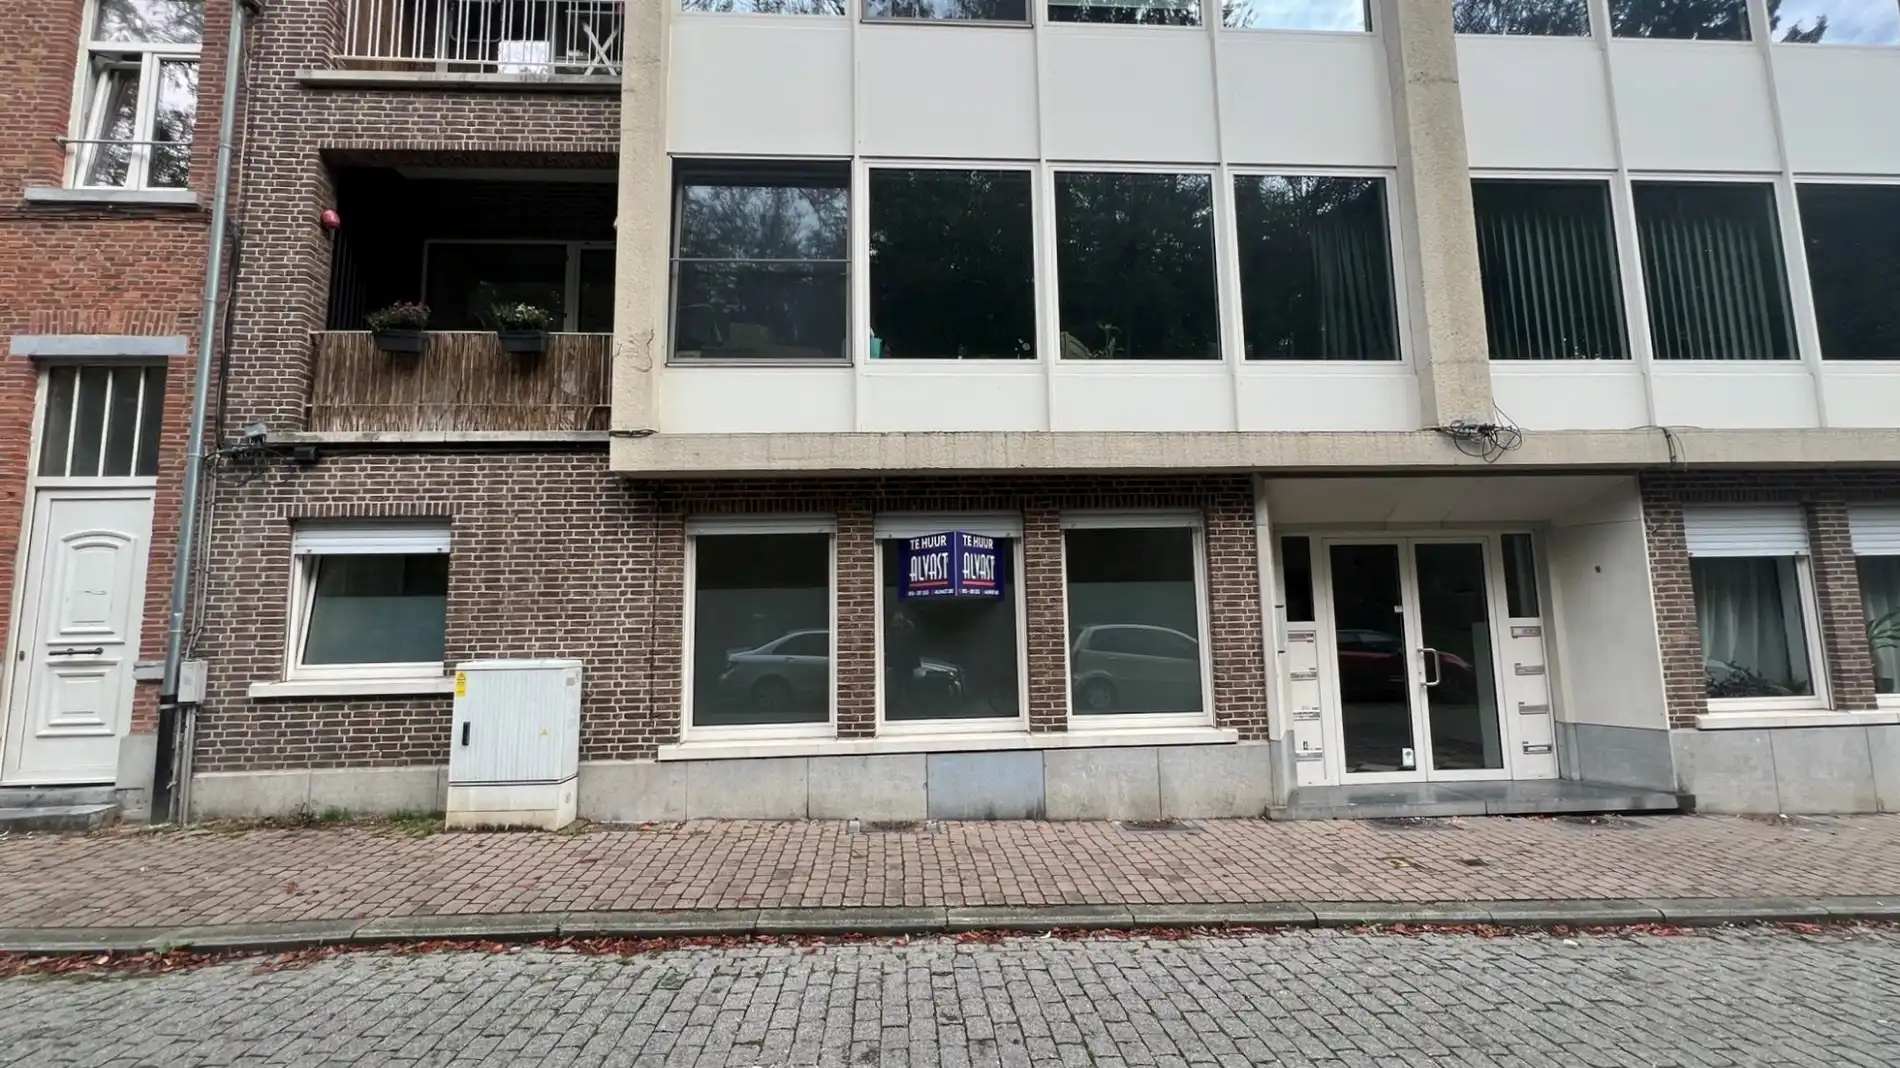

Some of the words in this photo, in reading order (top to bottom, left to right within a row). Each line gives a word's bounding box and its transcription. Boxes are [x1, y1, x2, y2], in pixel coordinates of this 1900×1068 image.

[910, 539, 919, 550] TE
[921, 535, 947, 548] HUUR
[963, 535, 971, 547] TE
[973, 536, 993, 549] HUUR
[909, 552, 948, 582] ALVAST
[962, 552, 995, 581] ALVAST
